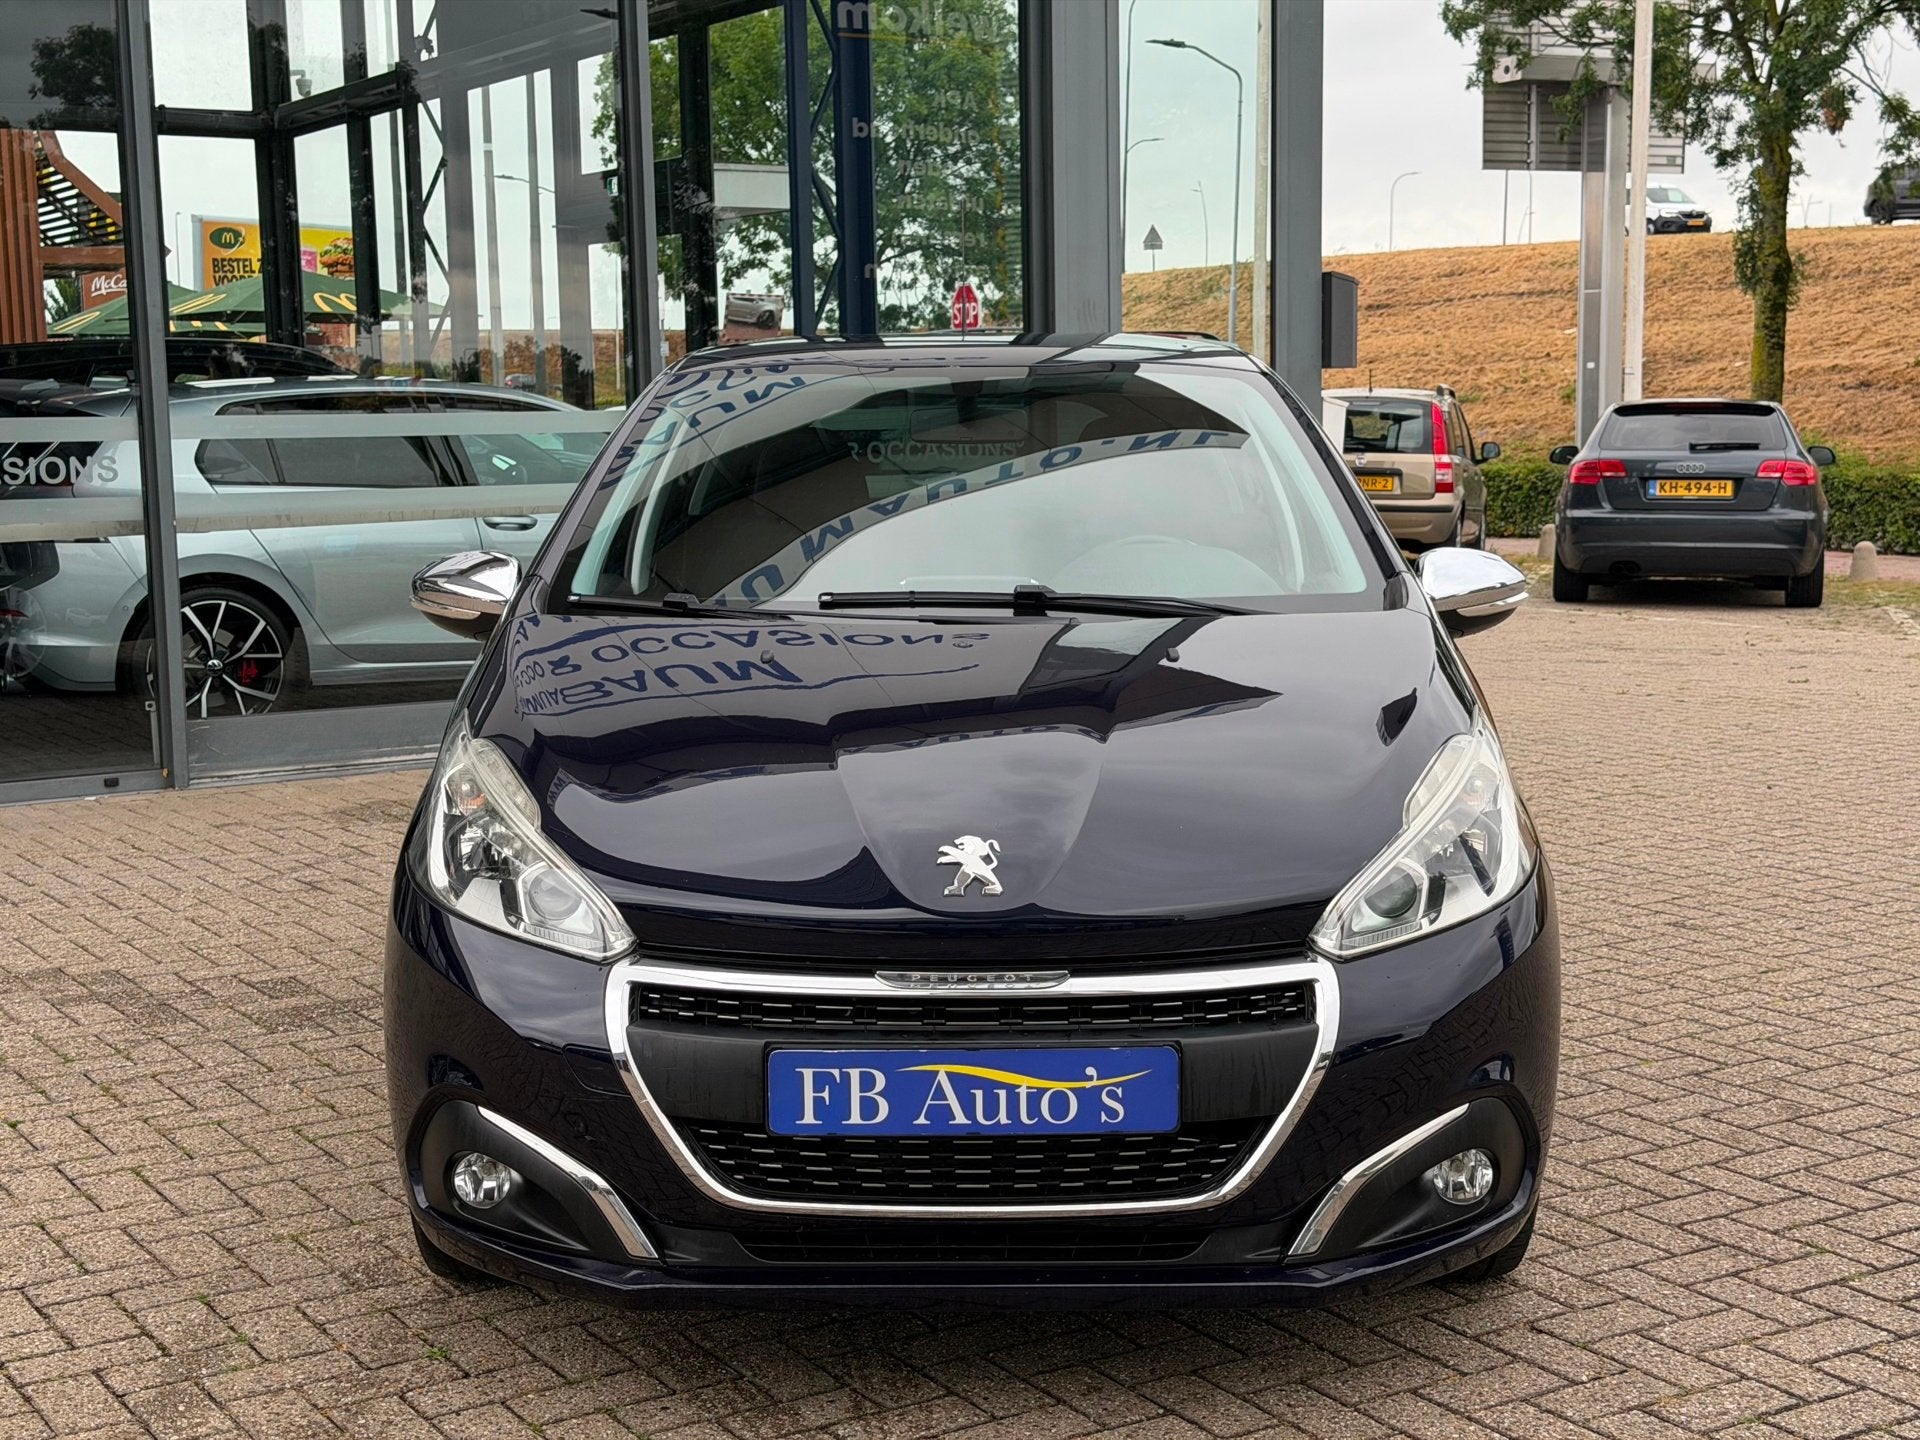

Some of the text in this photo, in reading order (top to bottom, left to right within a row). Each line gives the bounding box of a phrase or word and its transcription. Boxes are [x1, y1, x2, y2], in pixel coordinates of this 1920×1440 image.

[212, 257, 256, 274] BESTEL
[953, 302, 978, 325] STOP
[1658, 481, 1728, 494] KH-494-H
[911, 973, 1033, 982] PEUGEOT
[795, 1066, 1124, 1126] FB Auto's
